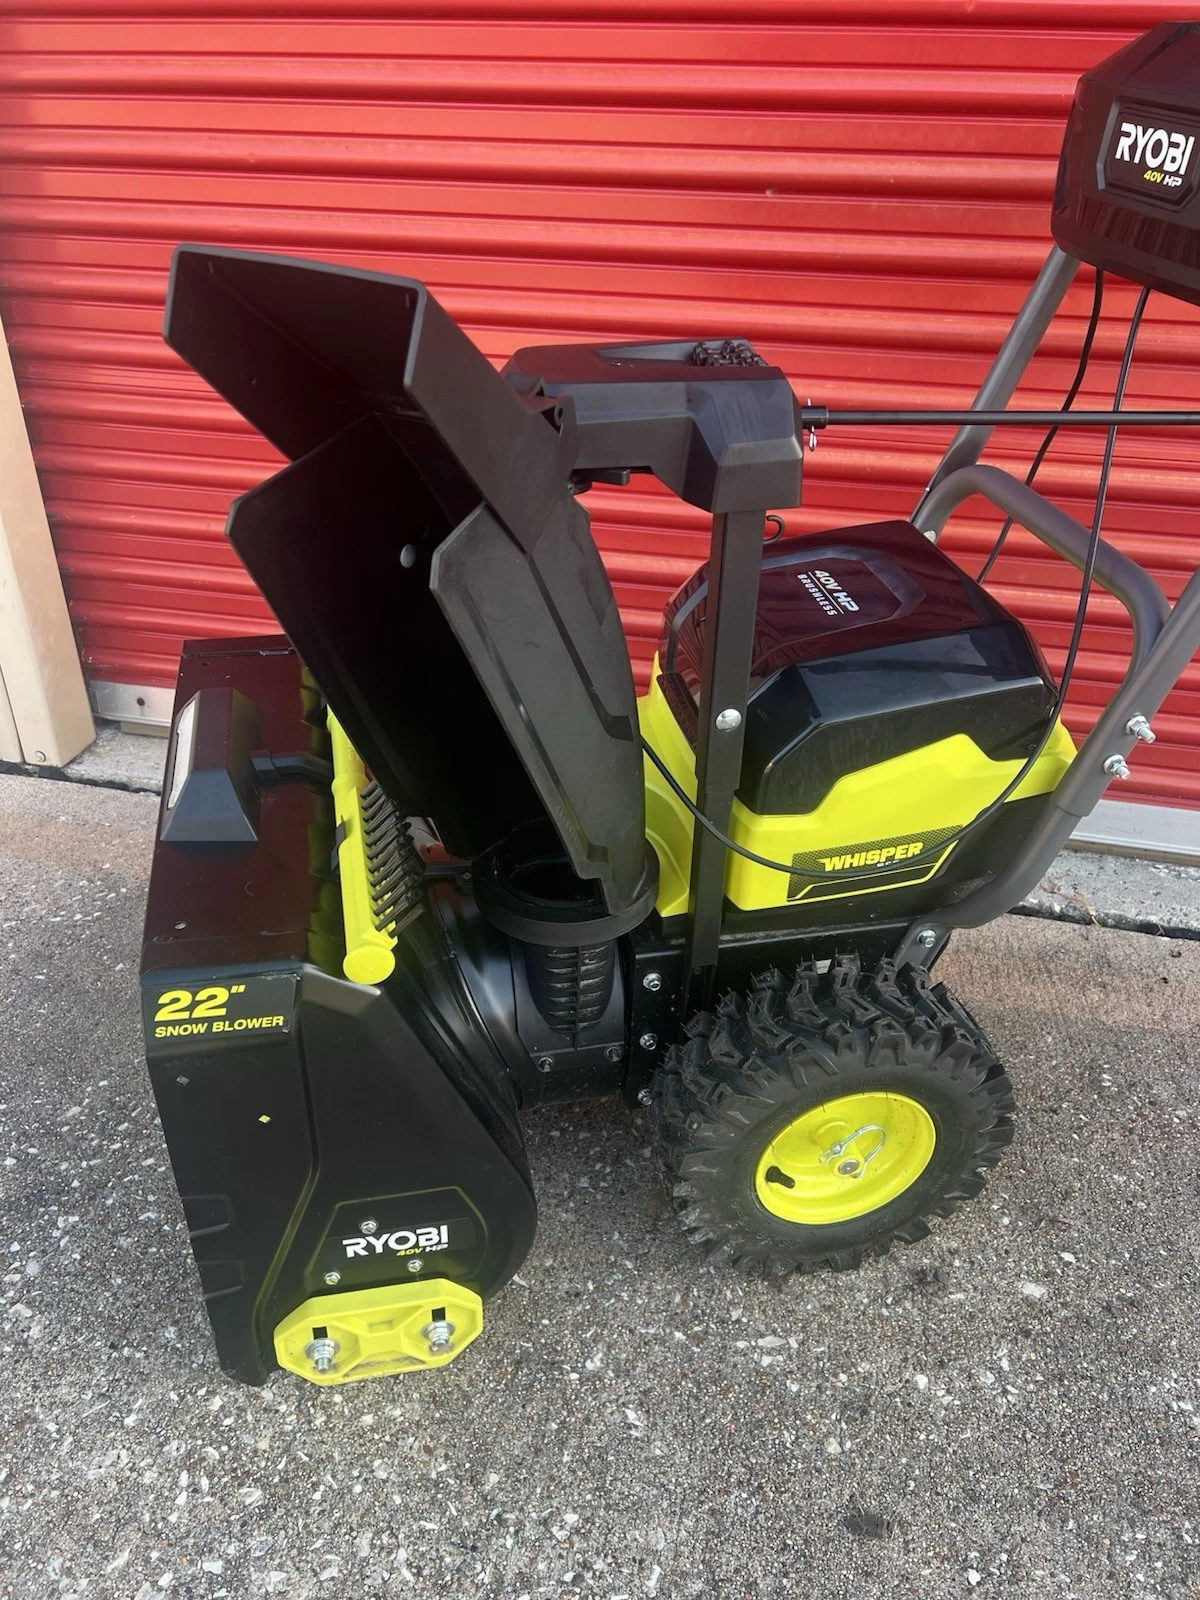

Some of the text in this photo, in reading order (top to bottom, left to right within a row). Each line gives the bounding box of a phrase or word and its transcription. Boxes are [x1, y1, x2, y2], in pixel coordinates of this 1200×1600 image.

[1115, 122, 1195, 175] RYOBI
[1143, 169, 1183, 187] 40V HP
[797, 573, 838, 616] BRUSHLESS
[814, 570, 860, 612] 40V HP
[816, 841, 924, 872] WHISPER
[154, 984, 246, 1022] 22"
[154, 1015, 284, 1038] SNOW BLOWER
[342, 1224, 449, 1258] RYOBI
[396, 1243, 449, 1257] 40V HP
